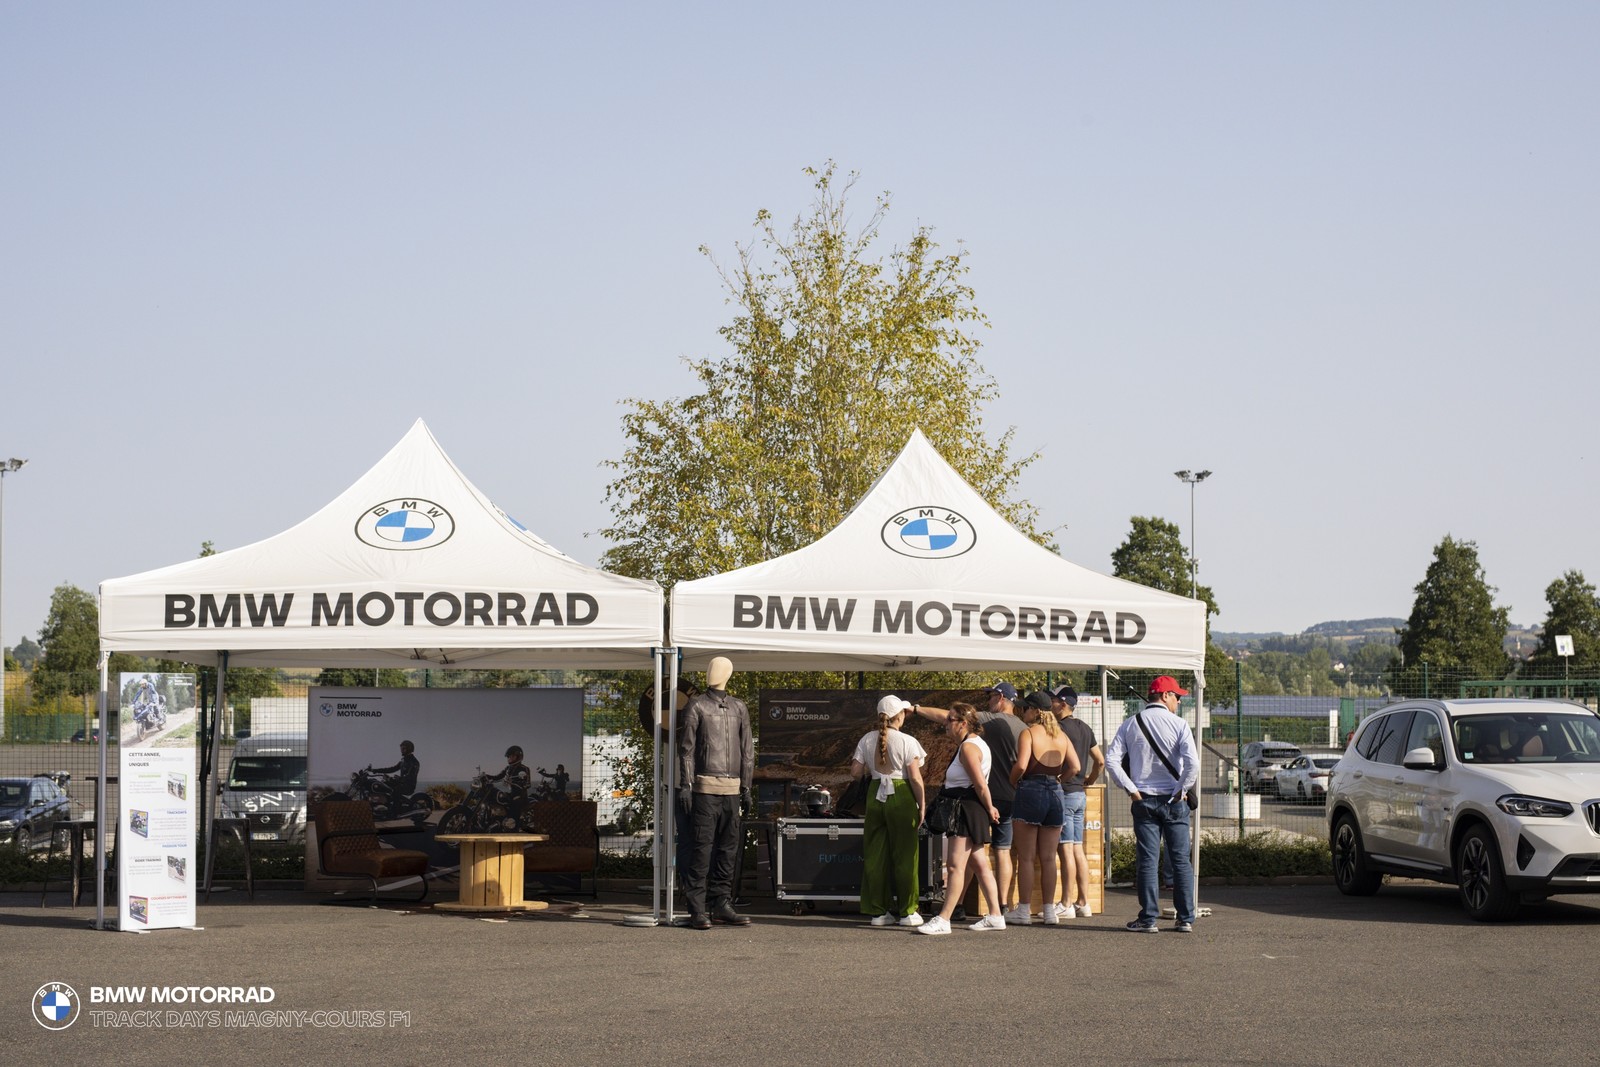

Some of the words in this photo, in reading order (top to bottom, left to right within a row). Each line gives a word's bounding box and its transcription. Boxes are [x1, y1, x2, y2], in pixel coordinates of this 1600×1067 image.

[372, 501, 444, 518] BMW
[893, 509, 961, 526] BMW
[164, 592, 294, 628] BMW
[311, 591, 599, 627] MOTORRAD
[732, 594, 857, 632] BMW
[873, 599, 1147, 645] MOTORRAD
[245, 790, 296, 812] SAVY
